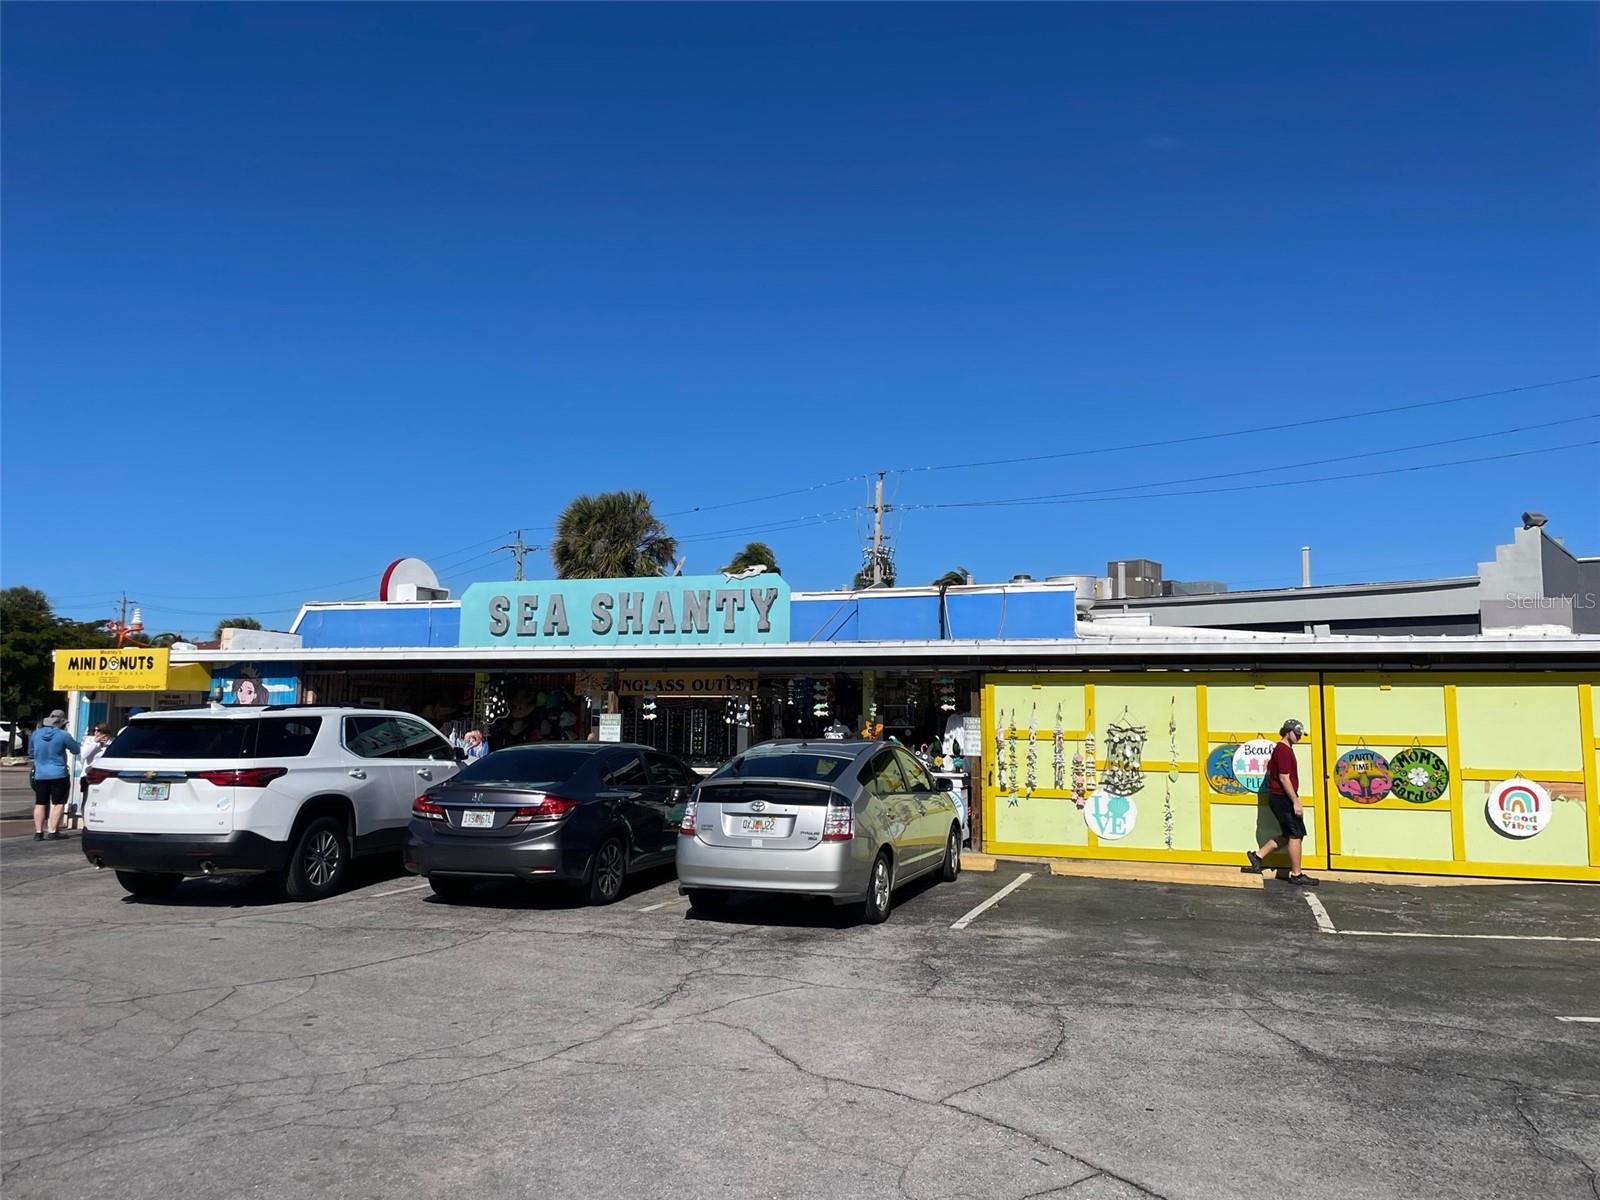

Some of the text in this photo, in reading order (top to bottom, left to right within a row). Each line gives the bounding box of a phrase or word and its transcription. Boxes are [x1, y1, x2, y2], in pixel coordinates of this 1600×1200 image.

[489, 587, 778, 636] SEA SHANTY
[68, 656, 154, 670] MINI DONUTS
[1348, 753, 1375, 762] PARTY
[1396, 750, 1443, 771] MOM'S
[1392, 777, 1446, 802] Garden
[1502, 812, 1537, 823] Good
[1502, 820, 1538, 831] Vibes
